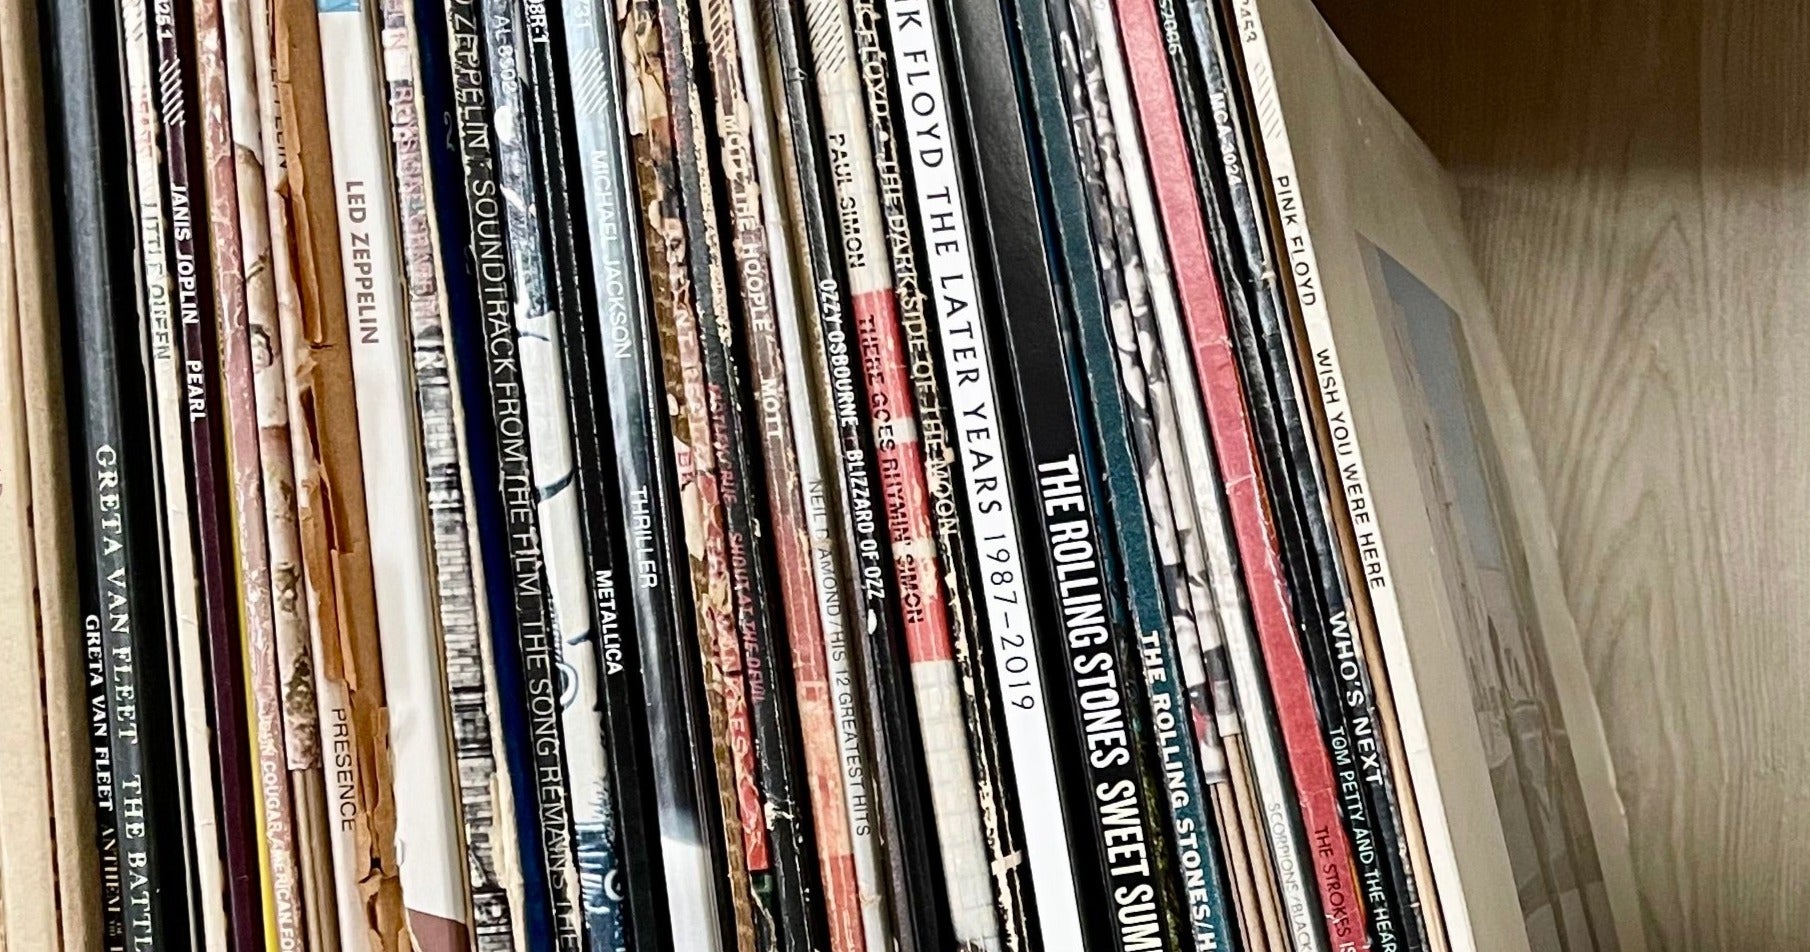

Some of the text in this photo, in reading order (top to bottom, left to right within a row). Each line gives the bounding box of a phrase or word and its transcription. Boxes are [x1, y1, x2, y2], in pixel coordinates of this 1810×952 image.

[453, 14, 490, 148] ZEPPELIN
[860, 30, 888, 117] FLOYD
[904, 50, 943, 169] FLOYD
[1211, 92, 1242, 186] MCA-3024
[877, 157, 902, 208] THE
[926, 187, 958, 254] THE
[346, 181, 379, 344] LED ZEPPELIN
[472, 179, 516, 373] SOUNDTRACK
[890, 214, 917, 288] DARK
[171, 183, 205, 422] JANIS JOPLIN PEARL
[734, 189, 784, 440] THE HOOPLE MOTT
[820, 280, 842, 323] OZZY
[903, 296, 928, 354] SIDE
[941, 274, 978, 388] LATER
[590, 150, 658, 588] MICHAEL JACKSON THRILLER
[828, 134, 924, 624] PAUL SIMON THERE GOES RHYMIN' SIMON
[829, 331, 858, 427] OSBOURNE
[909, 362, 931, 392] OF
[1276, 175, 1386, 590] PINK FLOYD WISH YOU WERE HERE
[495, 382, 524, 462] FROM
[921, 405, 944, 451] THE
[963, 403, 1002, 515] YEARS
[95, 445, 121, 556] GRETA
[504, 473, 533, 523] THE
[846, 450, 878, 534] BLIZZARD
[929, 459, 957, 534] MOON
[1036, 454, 1085, 517] THE
[511, 533, 538, 597] FILM
[861, 540, 880, 562] OF
[864, 567, 885, 600] OZZ
[1048, 522, 1109, 647] ROLLING
[107, 568, 130, 634] VAN
[596, 570, 623, 674] METALLICA
[86, 615, 105, 686] GRETA
[520, 619, 550, 670] THE
[807, 481, 871, 837] NEIL 12 GREATEST HITS
[91, 696, 108, 736] VAN
[112, 647, 138, 745] FLEET
[530, 678, 560, 755] SONG
[1072, 654, 1130, 768] STONES
[1140, 630, 1162, 683] THE
[1155, 694, 1189, 808] ROLLING
[1328, 610, 1383, 787] WHO'S NEXT
[95, 747, 112, 812] FLEET
[332, 709, 357, 832] PRESENCE
[1329, 726, 1350, 765] TOM
[122, 775, 145, 838] THE
[262, 761, 282, 831] COUGAR
[538, 767, 572, 890] REMAINS
[1096, 781, 1150, 877] SWEET
[1340, 772, 1364, 821] PETTY
[101, 824, 121, 912] ANTHEM
[271, 839, 293, 924] AMERICAN
[1314, 826, 1335, 858] THE
[1351, 828, 1375, 864] AND
[556, 900, 579, 948] THE
[1321, 863, 1351, 938] STROKES
[1362, 870, 1386, 904] THE
